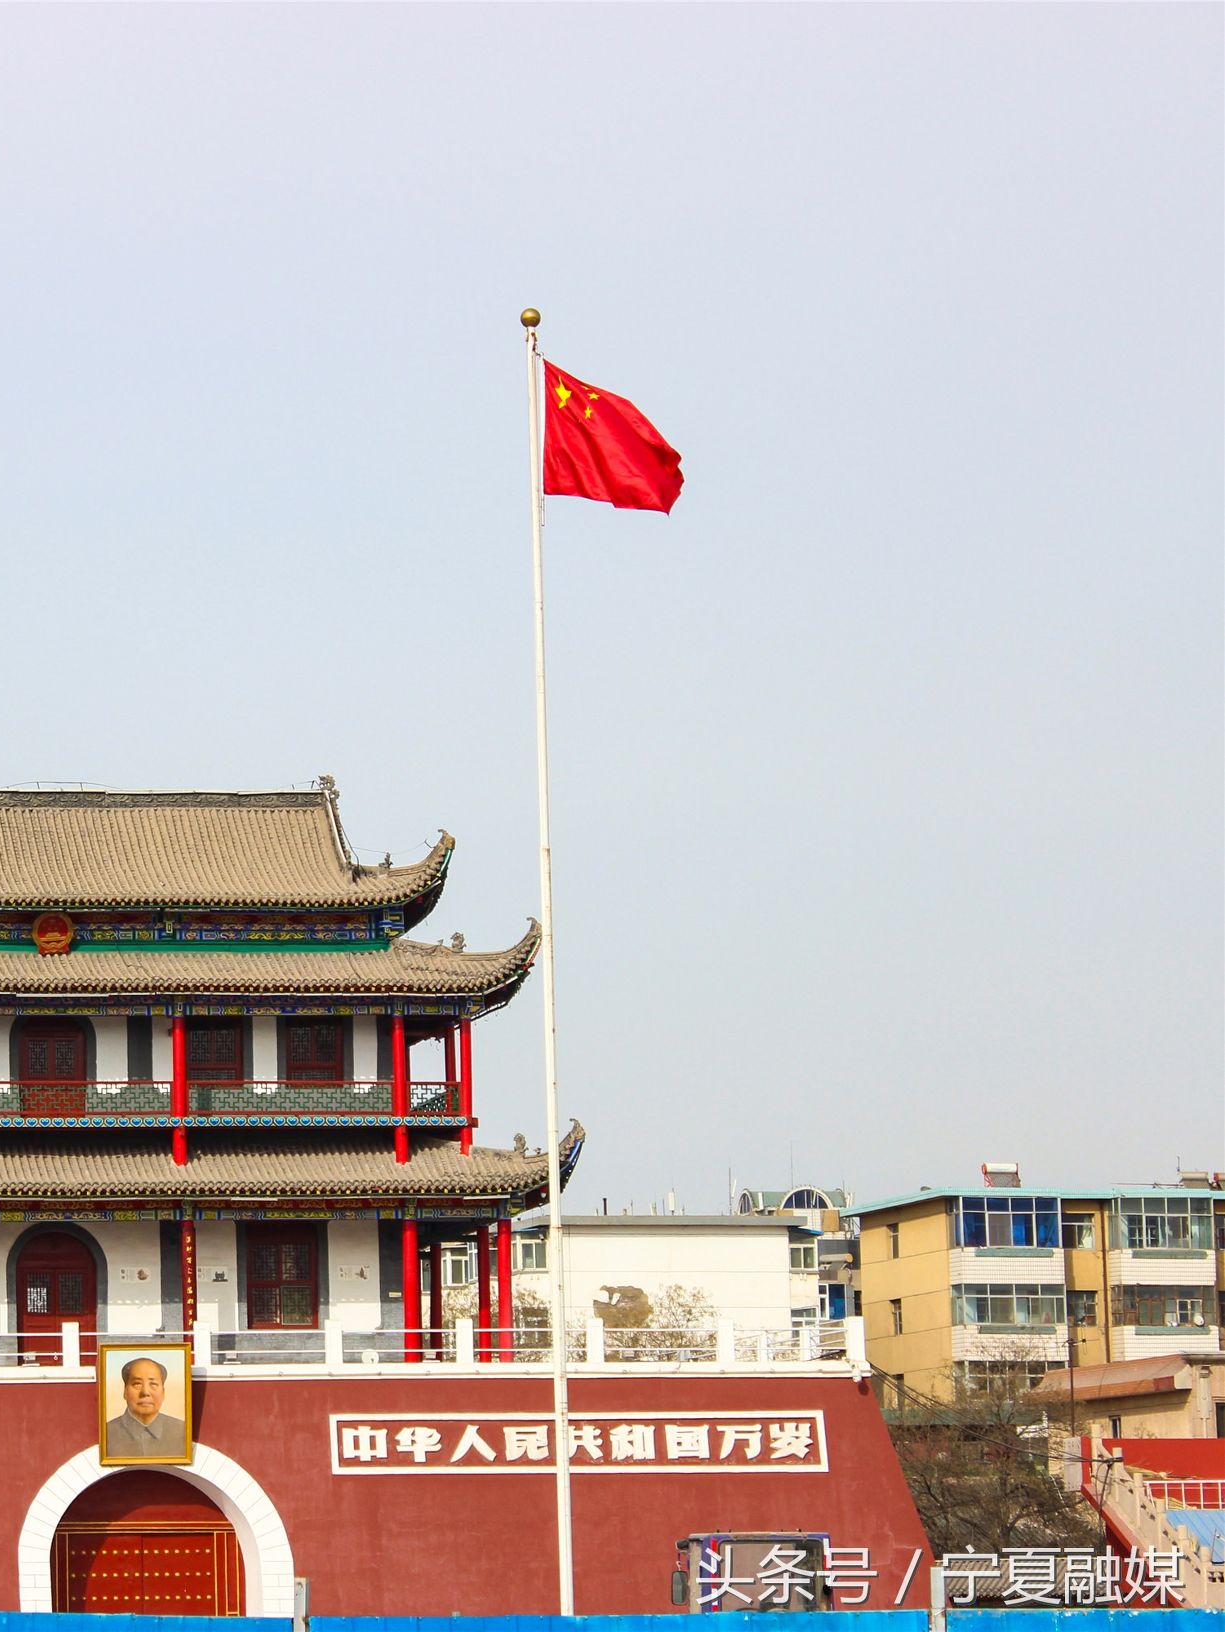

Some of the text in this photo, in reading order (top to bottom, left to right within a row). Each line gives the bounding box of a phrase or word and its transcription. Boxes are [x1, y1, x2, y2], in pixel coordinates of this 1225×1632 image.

[342, 1422, 813, 1463] 中华人民共和国万岁
